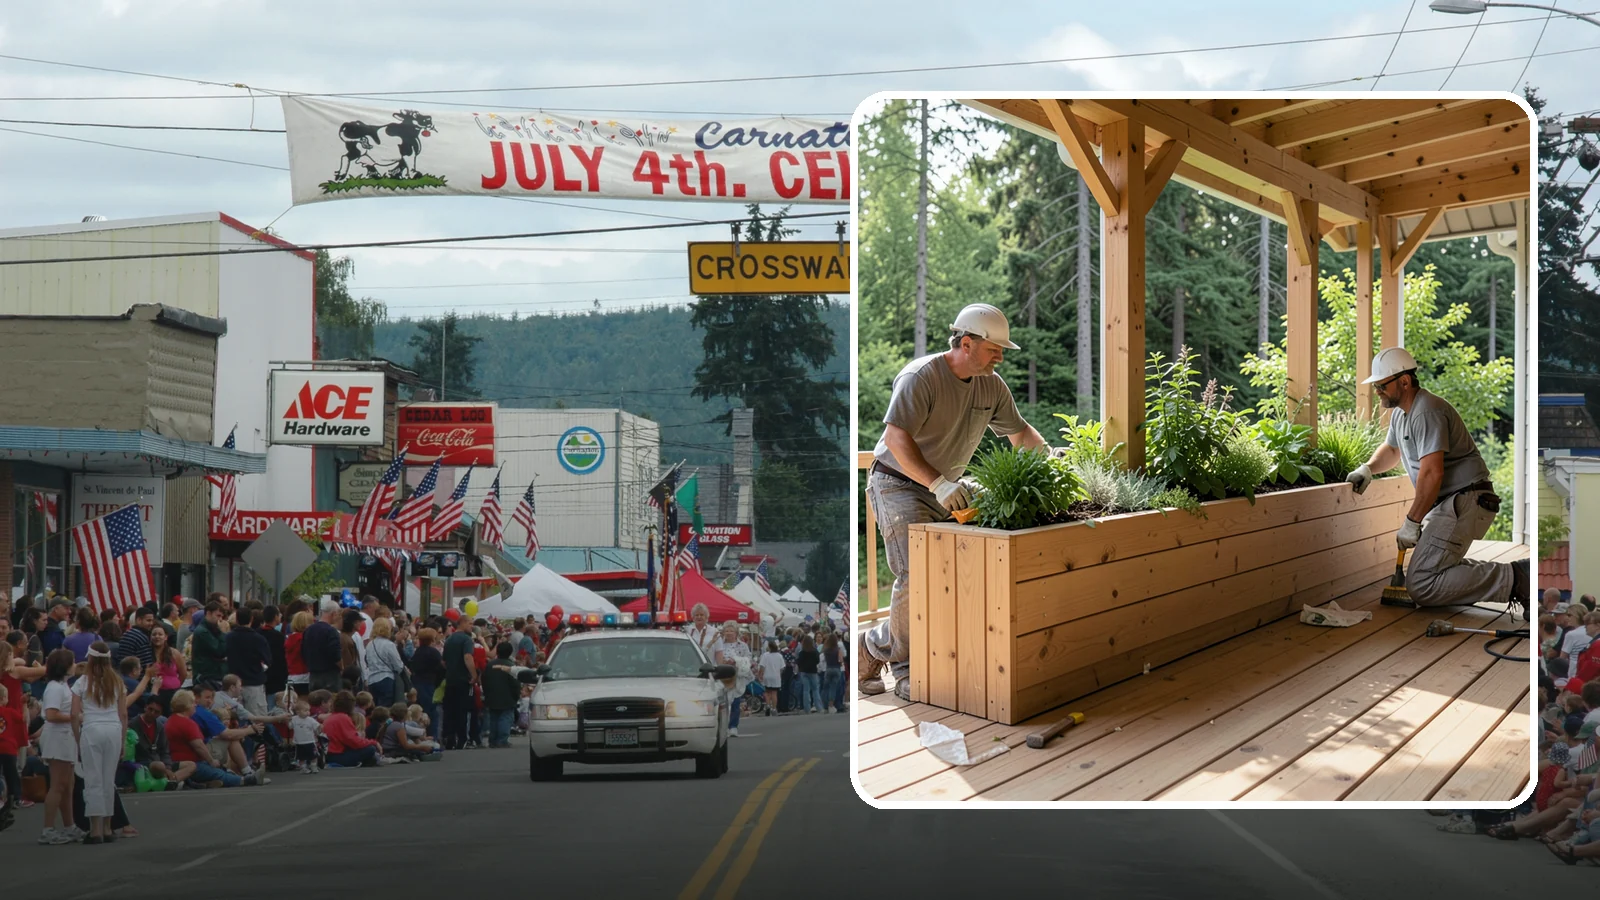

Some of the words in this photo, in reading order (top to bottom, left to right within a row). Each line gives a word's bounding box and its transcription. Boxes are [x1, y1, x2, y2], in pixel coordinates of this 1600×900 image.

[695, 121, 850, 149] Carnat
[481, 140, 605, 192] JULY
[632, 150, 746, 198] 4th.
[697, 254, 850, 280] CROSSWA
[282, 380, 373, 420] ACE
[405, 409, 453, 421] CEDAR
[283, 421, 371, 436] Hardware
[416, 428, 476, 446] Coca-Cola
[353, 467, 385, 480] Simpl
[95, 485, 124, 495] Vincent
[126, 486, 136, 495] de
[137, 486, 155, 495] Paul
[688, 526, 741, 535] CRNATION
[699, 535, 730, 543] GLASS
